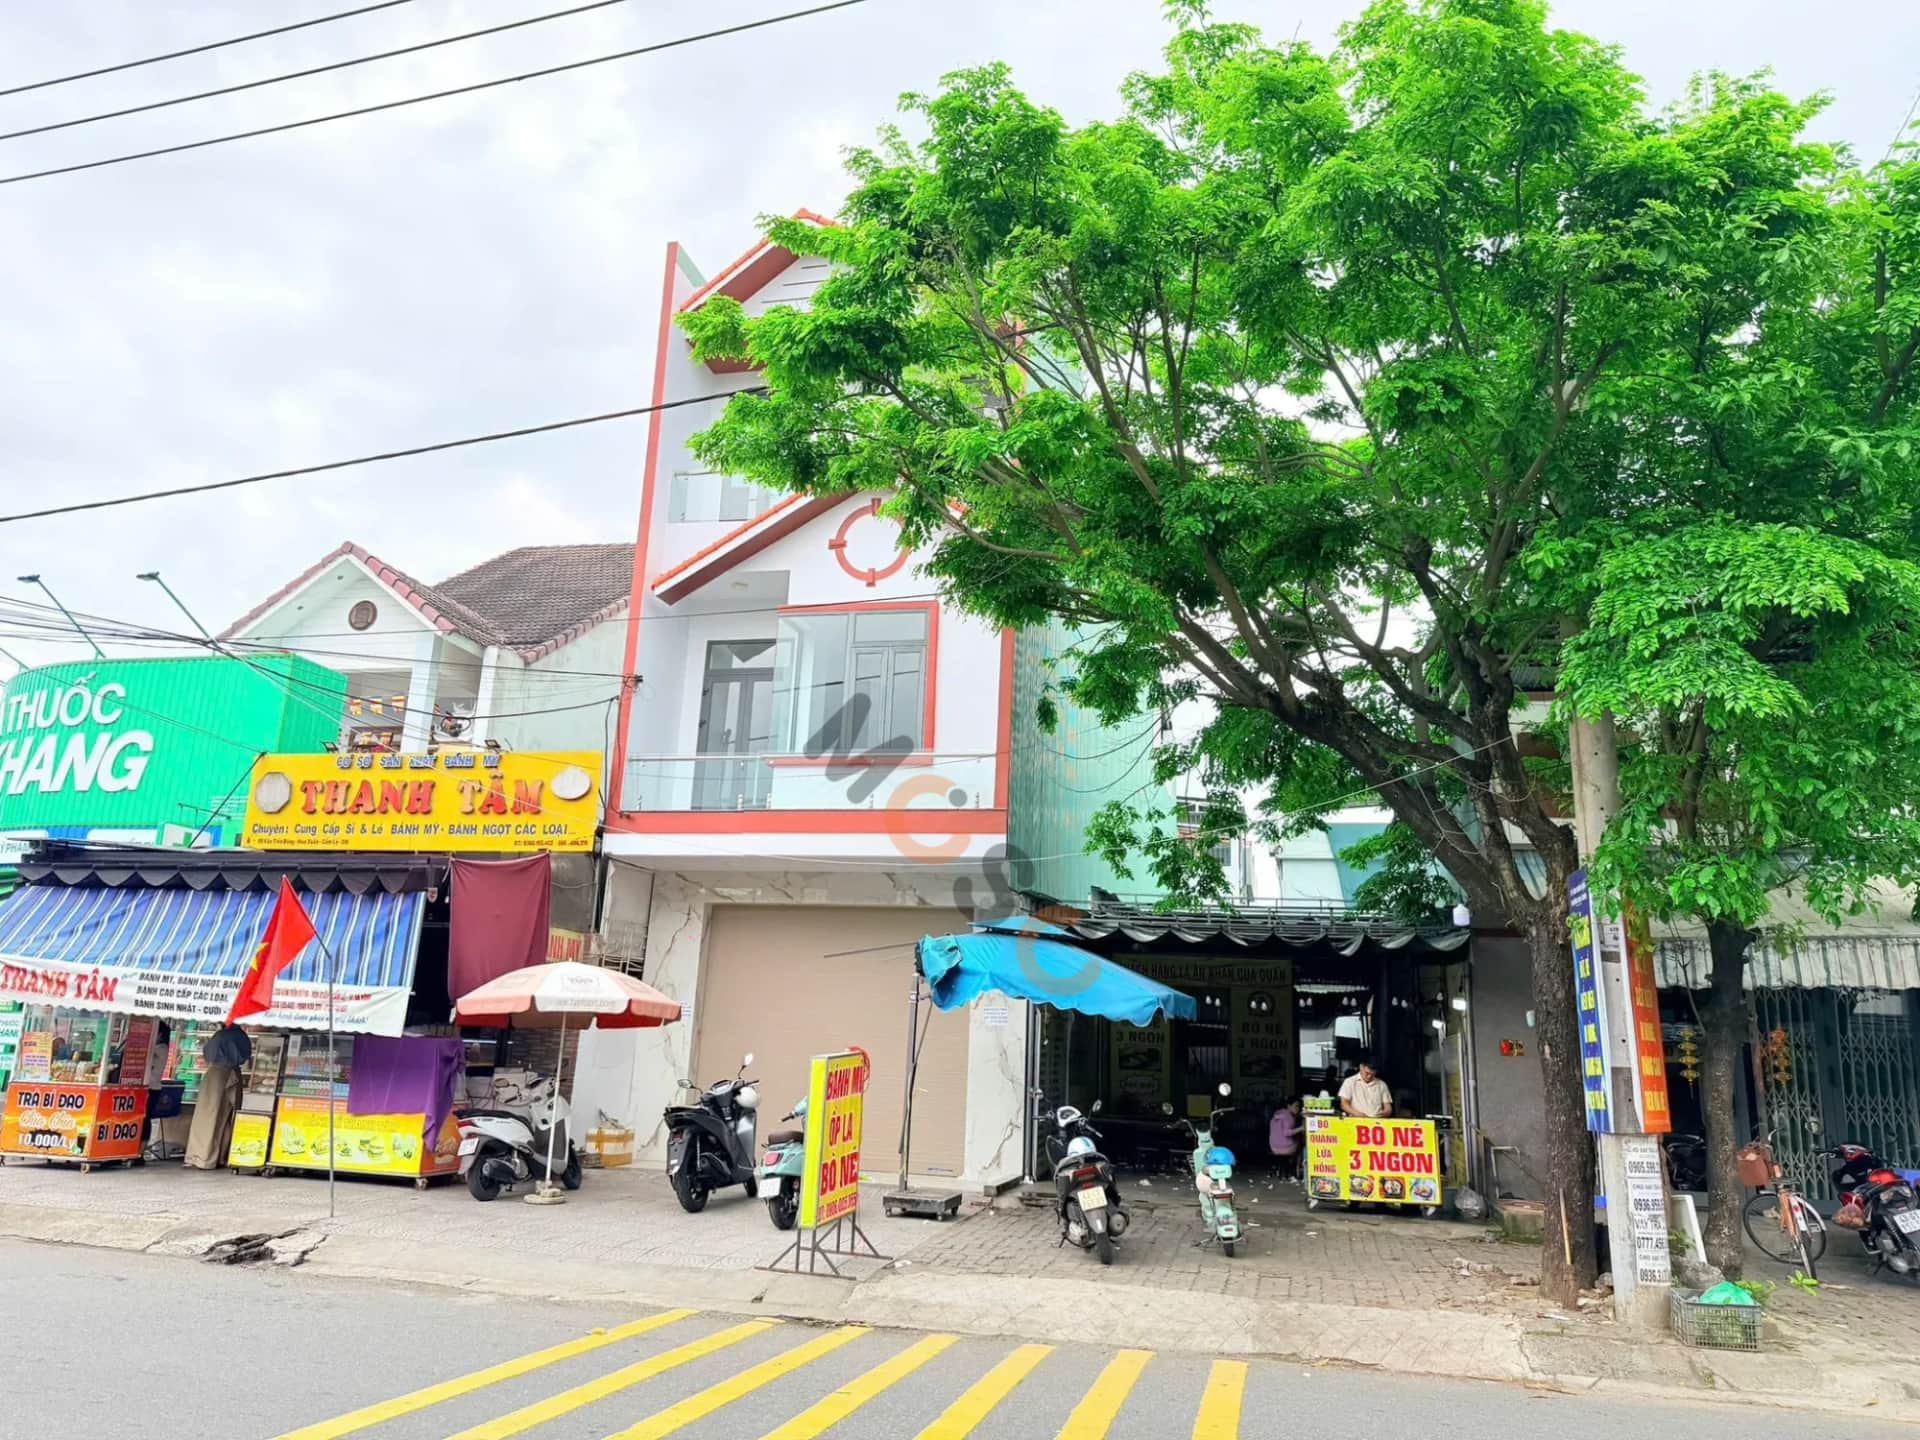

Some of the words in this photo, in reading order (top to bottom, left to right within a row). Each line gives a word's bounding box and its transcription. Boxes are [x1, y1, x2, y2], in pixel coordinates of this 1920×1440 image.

[7, 671, 126, 733] THUỐC
[300, 779, 436, 815] THANH
[459, 768, 545, 815] TÂM
[252, 823, 289, 836] Chuyên:
[294, 823, 317, 836] Cung
[360, 823, 367, 834] &
[391, 822, 420, 835] BÁNH
[448, 822, 478, 835] BÁNH
[482, 823, 512, 837] NGỌT
[515, 821, 537, 835] CÁC
[0, 964, 70, 996] THANH
[74, 968, 119, 1001] TÂM
[159, 988, 175, 997] CAO
[156, 1001, 175, 1011] SINH
[826, 1064, 850, 1101] BÁNH
[58, 1094, 85, 1109] ĐAO
[113, 1123, 138, 1140] ĐAO
[829, 1105, 841, 1147] ỐP
[842, 1112, 853, 1143] LA
[1355, 1121, 1385, 1146] BÒ
[1391, 1123, 1424, 1148] NÉ
[1310, 1134, 1338, 1144] QUANH
[820, 1152, 837, 1196] BÒ
[840, 1146, 859, 1188] NÉ
[1349, 1150, 1361, 1171] 3
[1368, 1151, 1434, 1174] NGON
